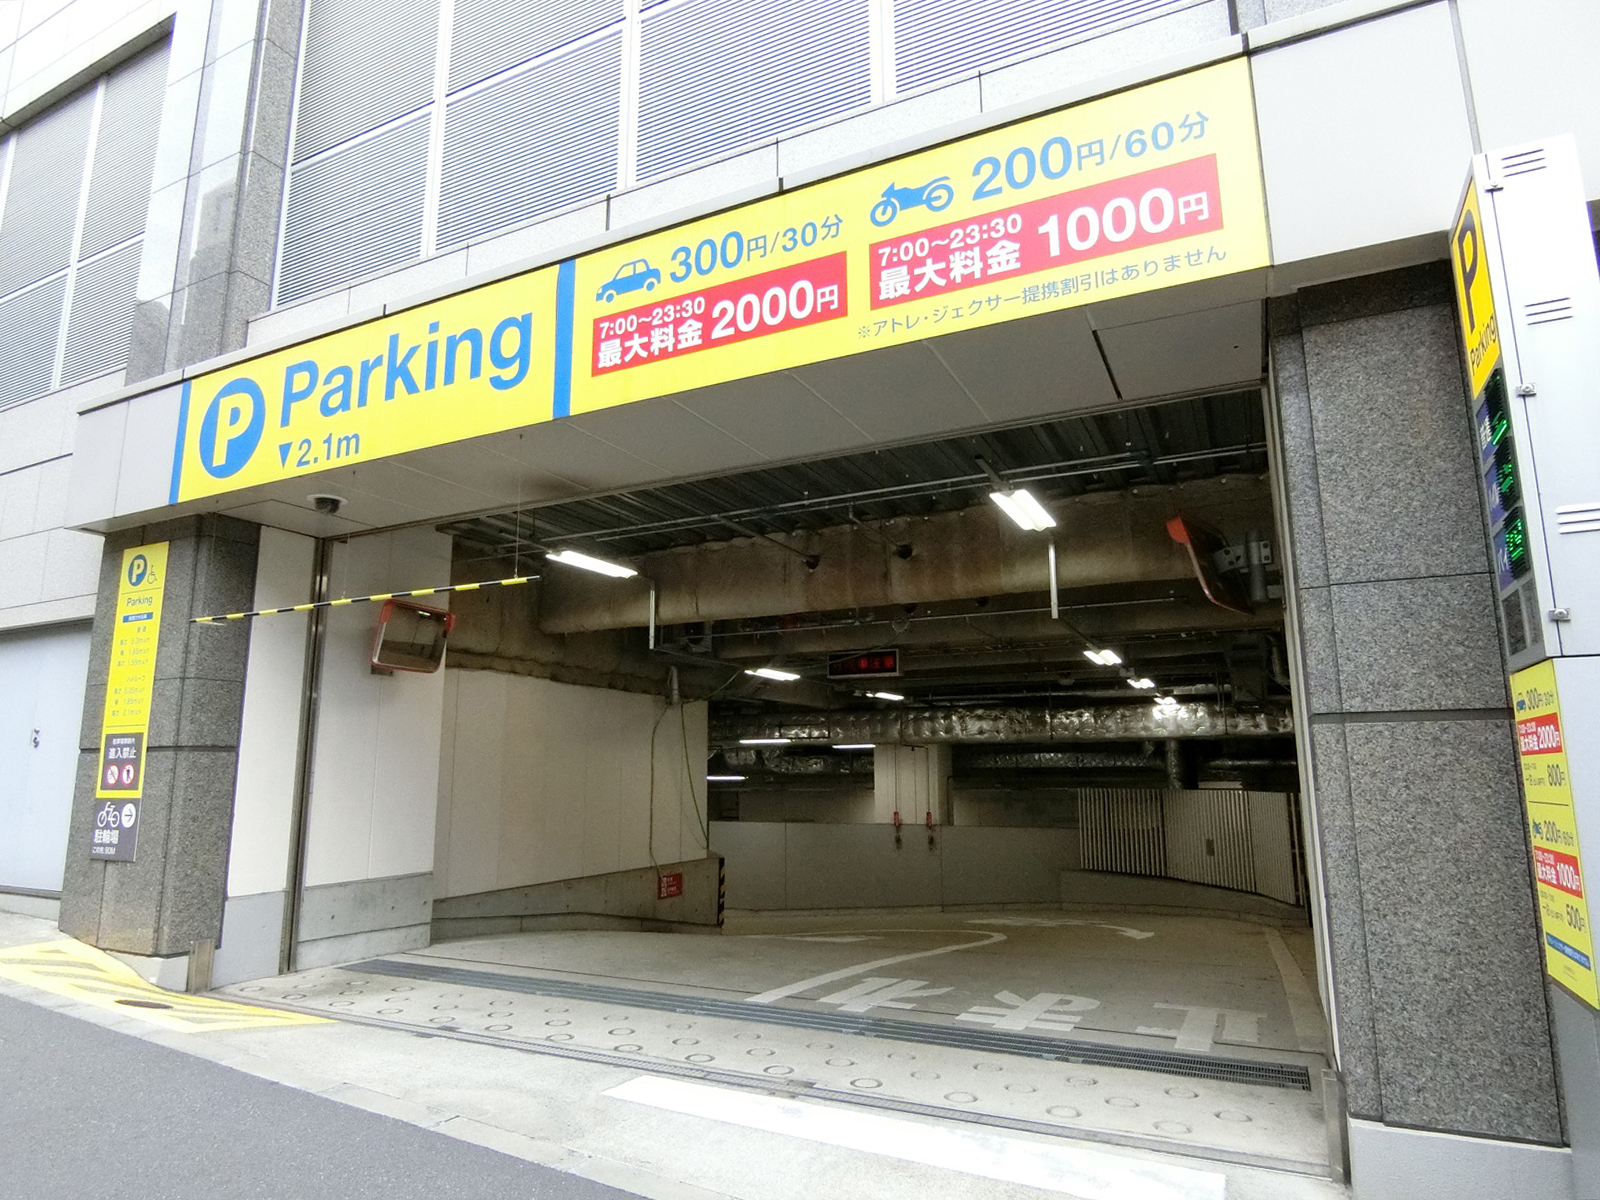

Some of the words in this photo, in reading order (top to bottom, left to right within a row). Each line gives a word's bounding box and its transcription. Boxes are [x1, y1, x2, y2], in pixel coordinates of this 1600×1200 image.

[972, 111, 1209, 201] 200円/60分
[669, 213, 844, 284] 300円/30分
[878, 240, 1021, 300] 最大料金
[1038, 187, 1210, 258] 1000円
[1457, 209, 1478, 334] P
[598, 319, 703, 368] 最大料金
[711, 280, 838, 339] 2000円
[1470, 314, 1497, 376] Parking
[280, 313, 533, 428] Parking
[212, 392, 255, 467] P
[296, 432, 360, 468] 2.1m
[127, 596, 153, 607] Parking
[131, 558, 144, 583] P
